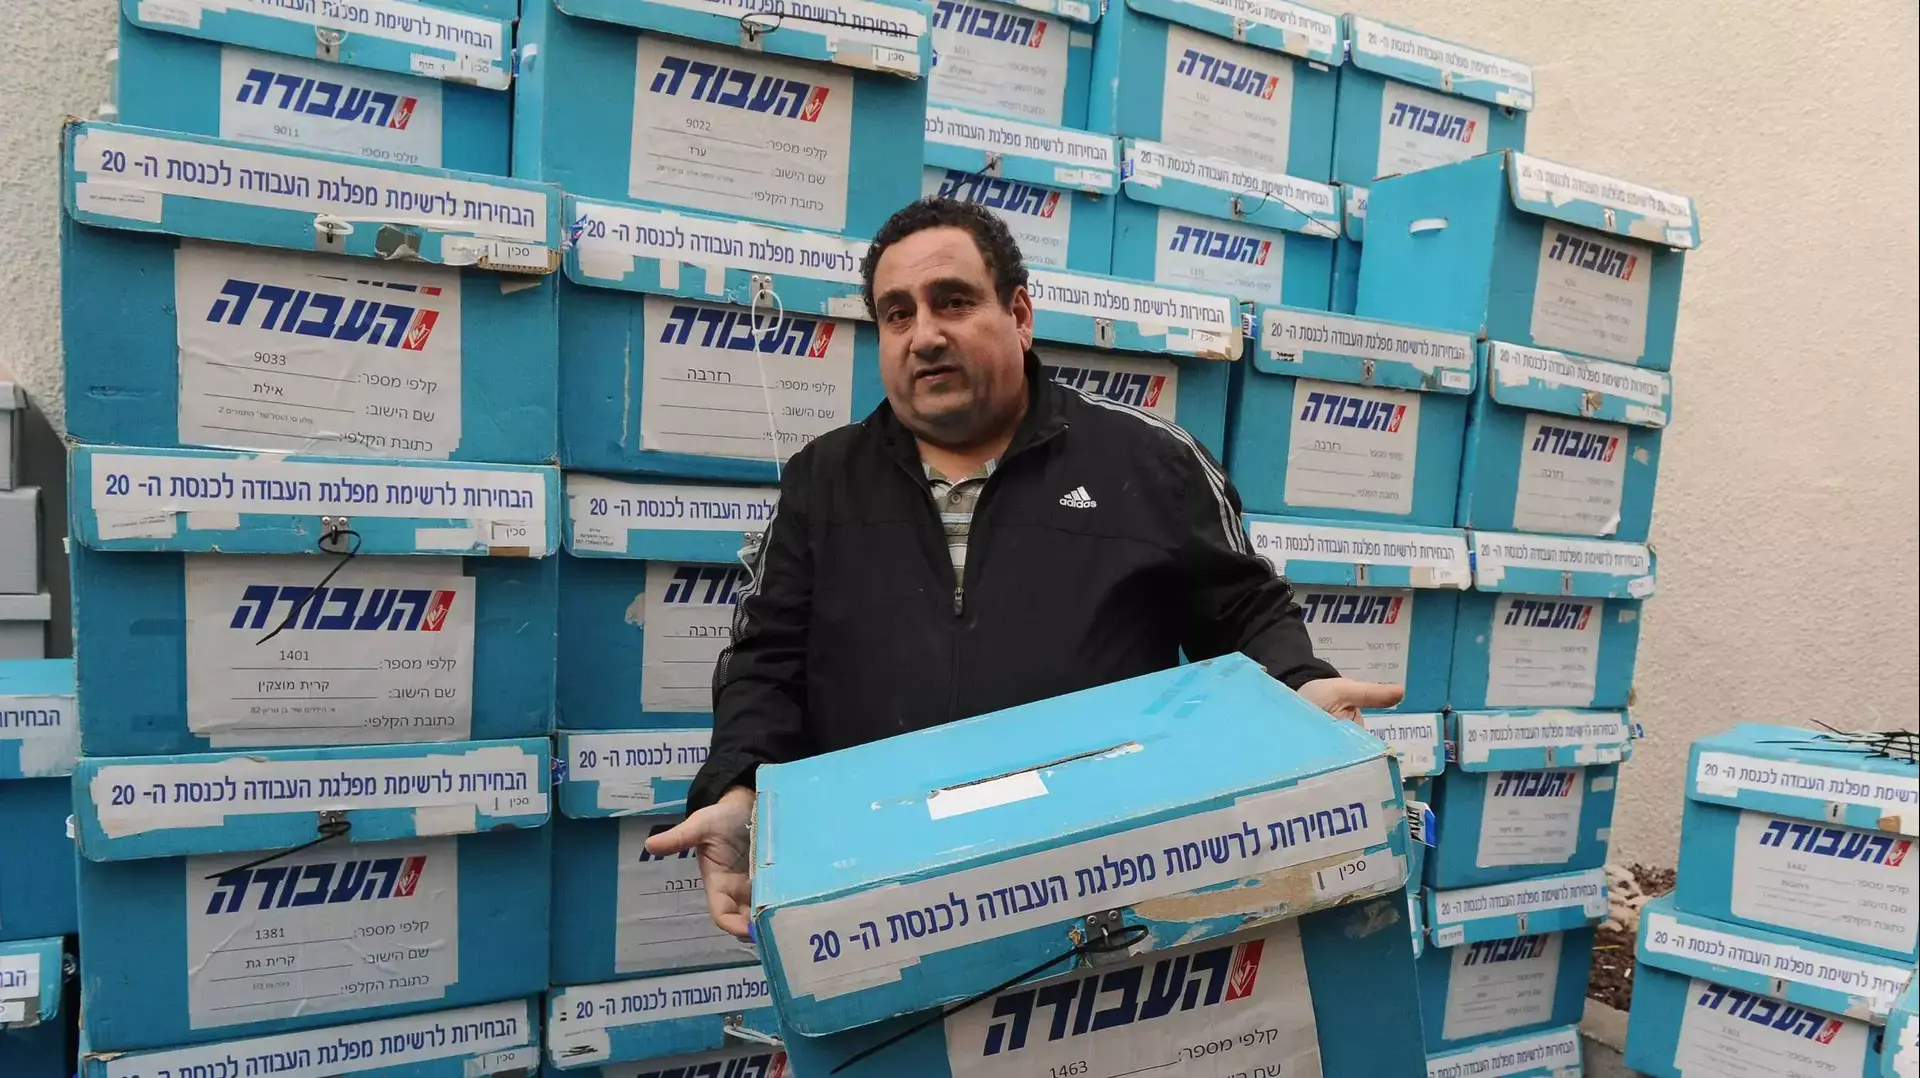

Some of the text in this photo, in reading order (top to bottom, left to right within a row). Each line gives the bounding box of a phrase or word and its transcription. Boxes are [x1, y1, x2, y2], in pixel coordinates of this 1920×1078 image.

[375, 11, 493, 49] הבחירות לרשימת
[932, 0, 1035, 46] העבודה
[1177, 49, 1268, 98] העבודה
[650, 56, 810, 119] העבודה
[236, 68, 399, 127] העבודה
[686, 118, 711, 132] 9022
[1389, 102, 1465, 142] העבודה
[274, 126, 299, 137] 9011
[948, 122, 1108, 161] הבחירות לרשימת מפלגת העבודה
[803, 145, 828, 160] קלפי
[1140, 151, 1151, 164] 20
[1169, 158, 1195, 175] לכנסת
[101, 150, 535, 227] הבחירות לרשימת מפלגת העבודה לכנסת 20
[809, 174, 825, 185] שם
[791, 197, 823, 211] כתובת
[507, 246, 530, 258] סכין
[587, 220, 853, 272] לרשימת מפלגת העבודה לכנסת 20
[1170, 225, 1260, 264] העבודה
[1549, 233, 1629, 280] העבודה
[206, 279, 416, 348] העבודה
[1049, 286, 1225, 324] הבחירות לרשימת מפלגת העבודה
[660, 306, 815, 357] העבודה
[1271, 323, 1283, 337] 20
[1300, 325, 1328, 343] לכנסת
[1331, 330, 1363, 347] העבודה
[1366, 333, 1393, 351] מפלגת
[254, 351, 286, 366] 9033
[1500, 349, 1510, 363] 20
[687, 368, 731, 383] רזרבה
[252, 382, 284, 396] אילת
[406, 378, 437, 394] קלפי
[811, 382, 836, 395] קלפי
[366, 404, 435, 422] שם הישוב:
[818, 409, 834, 420] שם
[1300, 392, 1395, 431] העבודה
[391, 439, 432, 452] כתובת
[1532, 425, 1609, 461] העבודה
[106, 472, 533, 508] הבחירות לרשימת מפלגת העבודה לכנסת 20
[590, 496, 741, 520] העבודה לכנסת 20
[1060, 498, 1097, 508] adidas
[506, 527, 526, 538] סכין
[1257, 534, 1268, 549] 20
[1271, 536, 1283, 550] ה-
[1286, 534, 1315, 551] לכנסת
[1317, 540, 1350, 554] העבודה
[1352, 539, 1380, 556] מפלגת
[230, 585, 432, 631] העבודה
[1301, 594, 1392, 624] העבודה
[1504, 600, 1584, 630] העבודה
[689, 625, 732, 637] רזרבה
[279, 650, 310, 661] 1401
[379, 658, 456, 672] קלפי מספר:
[258, 680, 330, 692] קרית מוצקין
[389, 688, 456, 699] שם הישוב:
[364, 715, 455, 730] כתובת הקלפי:
[1468, 729, 1477, 742] 20
[579, 742, 672, 768] לכנסת 20
[112, 769, 527, 805] הבחירות לרשימת מפלגת העבודה לכנסת 20
[1494, 772, 1567, 797] העבודה
[1704, 763, 1870, 798] מפלגת העבודה לכנסת ה- 20
[510, 797, 529, 808] סכין
[1267, 801, 1369, 850] הבחירות
[1163, 821, 1260, 876] לרשימת
[1759, 820, 1894, 865] העבודה
[1075, 852, 1156, 897] מפלגת
[1338, 859, 1367, 881] סכין
[205, 858, 404, 915] העבודה
[976, 875, 1068, 922] העבודה
[1441, 901, 1450, 915] 20
[886, 892, 969, 943] לכנסת
[255, 928, 285, 940] 1381
[354, 920, 429, 938] קלפי מספר:
[408, 948, 428, 958] שם
[809, 929, 841, 963] 20
[246, 954, 295, 969] קרית גת
[1654, 931, 1868, 988] לרשימת מפלגת העבודה לכנסת ה- 20
[389, 975, 428, 990] כתובת
[576, 978, 770, 1019] מפלגת העבודה לכנסת 20
[982, 945, 1234, 1057] העבודה
[1698, 984, 1827, 1040] העבודה
[246, 1016, 517, 1075] הבחירות לרשימת מפלגת העבודה
[1178, 1028, 1278, 1062] קלפי מספר:
[1050, 1060, 1088, 1078] 1463
